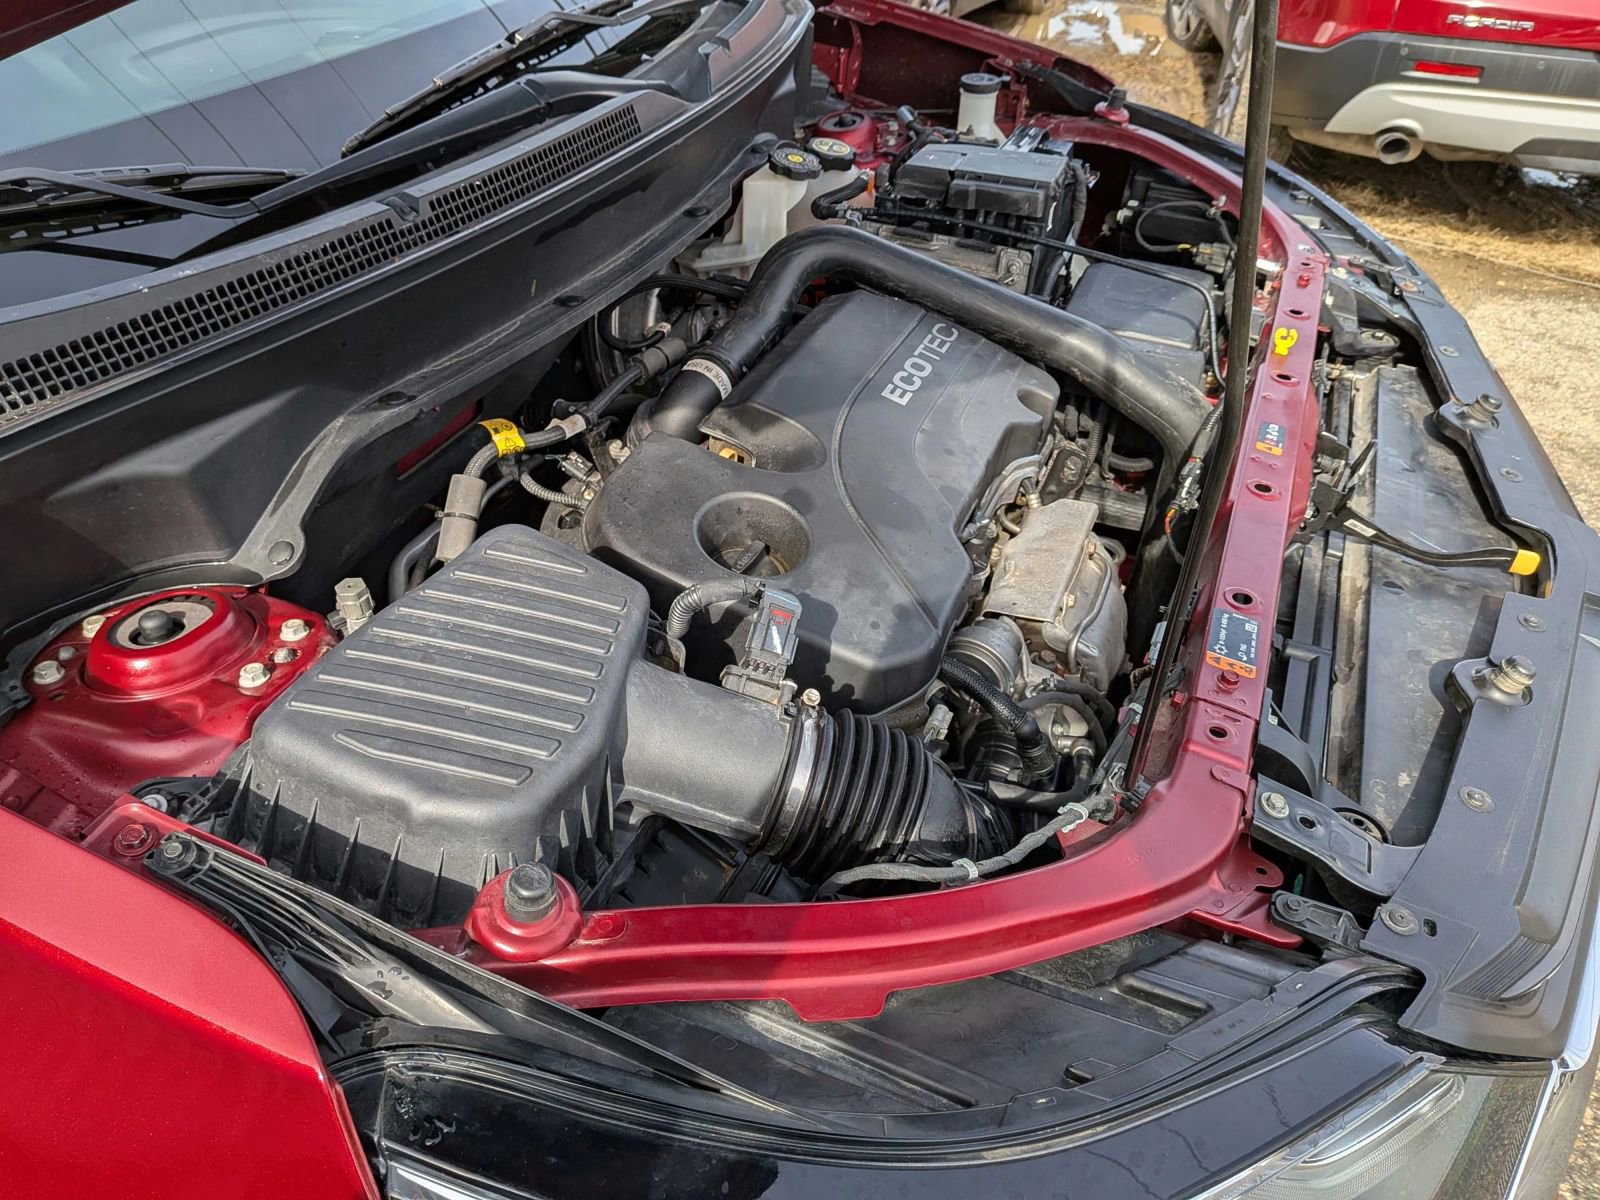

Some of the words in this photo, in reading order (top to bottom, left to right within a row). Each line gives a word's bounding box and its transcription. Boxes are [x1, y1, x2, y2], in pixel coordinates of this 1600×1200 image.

[703, 365, 714, 374] IN
[881, 323, 959, 406] ECOTEC
[713, 371, 729, 396] MADE
